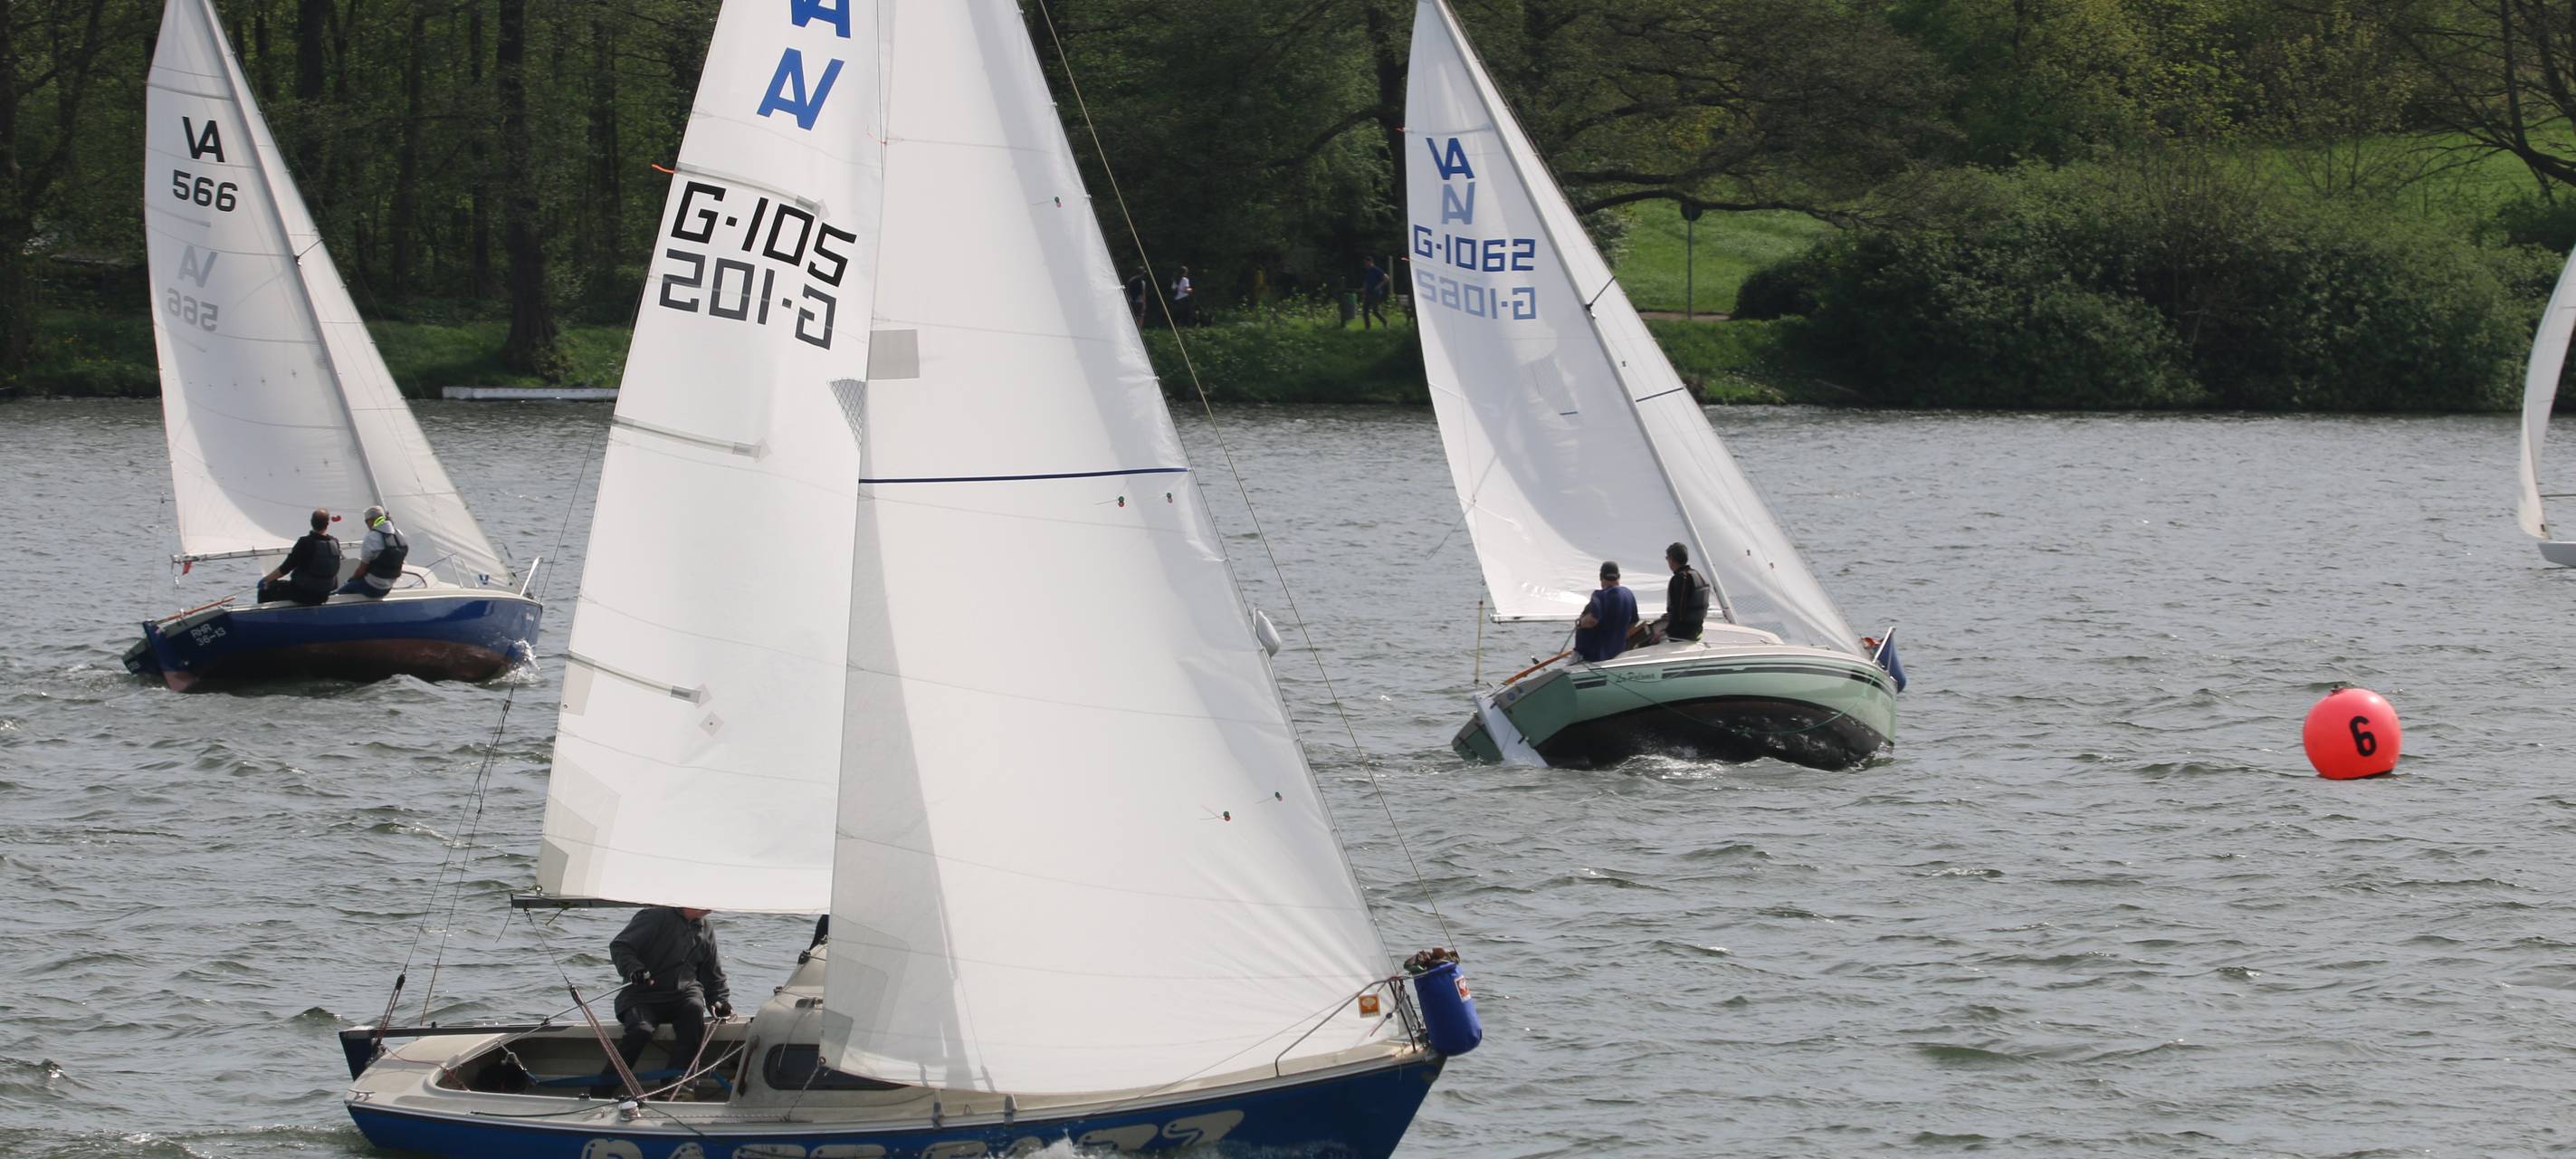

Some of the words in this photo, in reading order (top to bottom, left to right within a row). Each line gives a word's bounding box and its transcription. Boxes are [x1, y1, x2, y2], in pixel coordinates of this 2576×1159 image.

[182, 116, 225, 162] VA
[1426, 138, 1475, 180] VA
[172, 169, 238, 212] 566
[2350, 715, 2377, 757] 6
